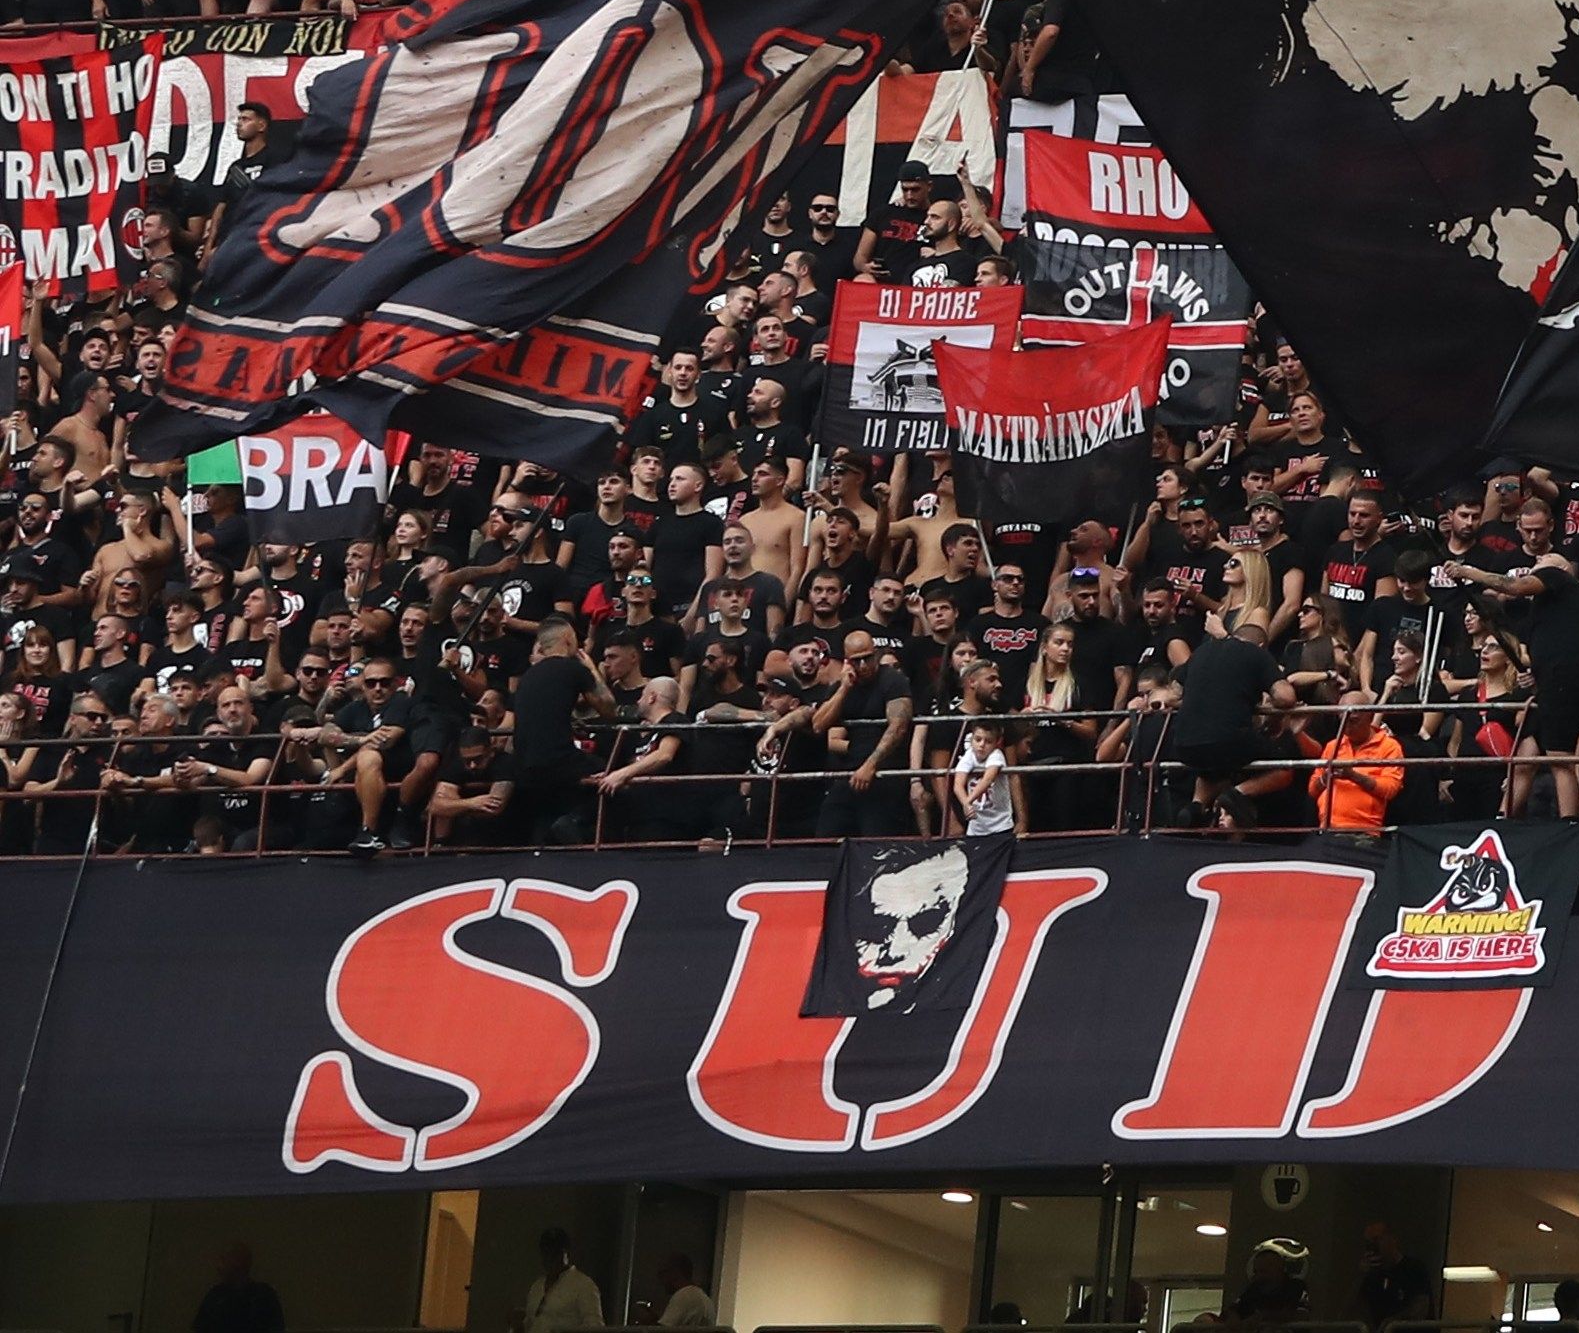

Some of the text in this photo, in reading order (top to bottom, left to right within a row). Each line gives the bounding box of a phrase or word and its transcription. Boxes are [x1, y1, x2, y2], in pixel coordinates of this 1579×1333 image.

[205, 24, 271, 54] CON
[284, 18, 349, 55] NOI
[0, 53, 155, 122] ON TI HO
[0, 131, 146, 201] RADITO
[1088, 151, 1191, 220] RHO
[20, 217, 117, 281] MAI
[880, 289, 982, 321] DI PADRE
[1063, 248, 1209, 323] OUTLAWS
[863, 419, 951, 452] IN FIGLI
[241, 436, 389, 511] BRA
[1402, 906, 1531, 938] WARNING!
[1446, 934, 1472, 959] IS
[1474, 932, 1537, 959] HERE
[282, 859, 1531, 1174] SUD
